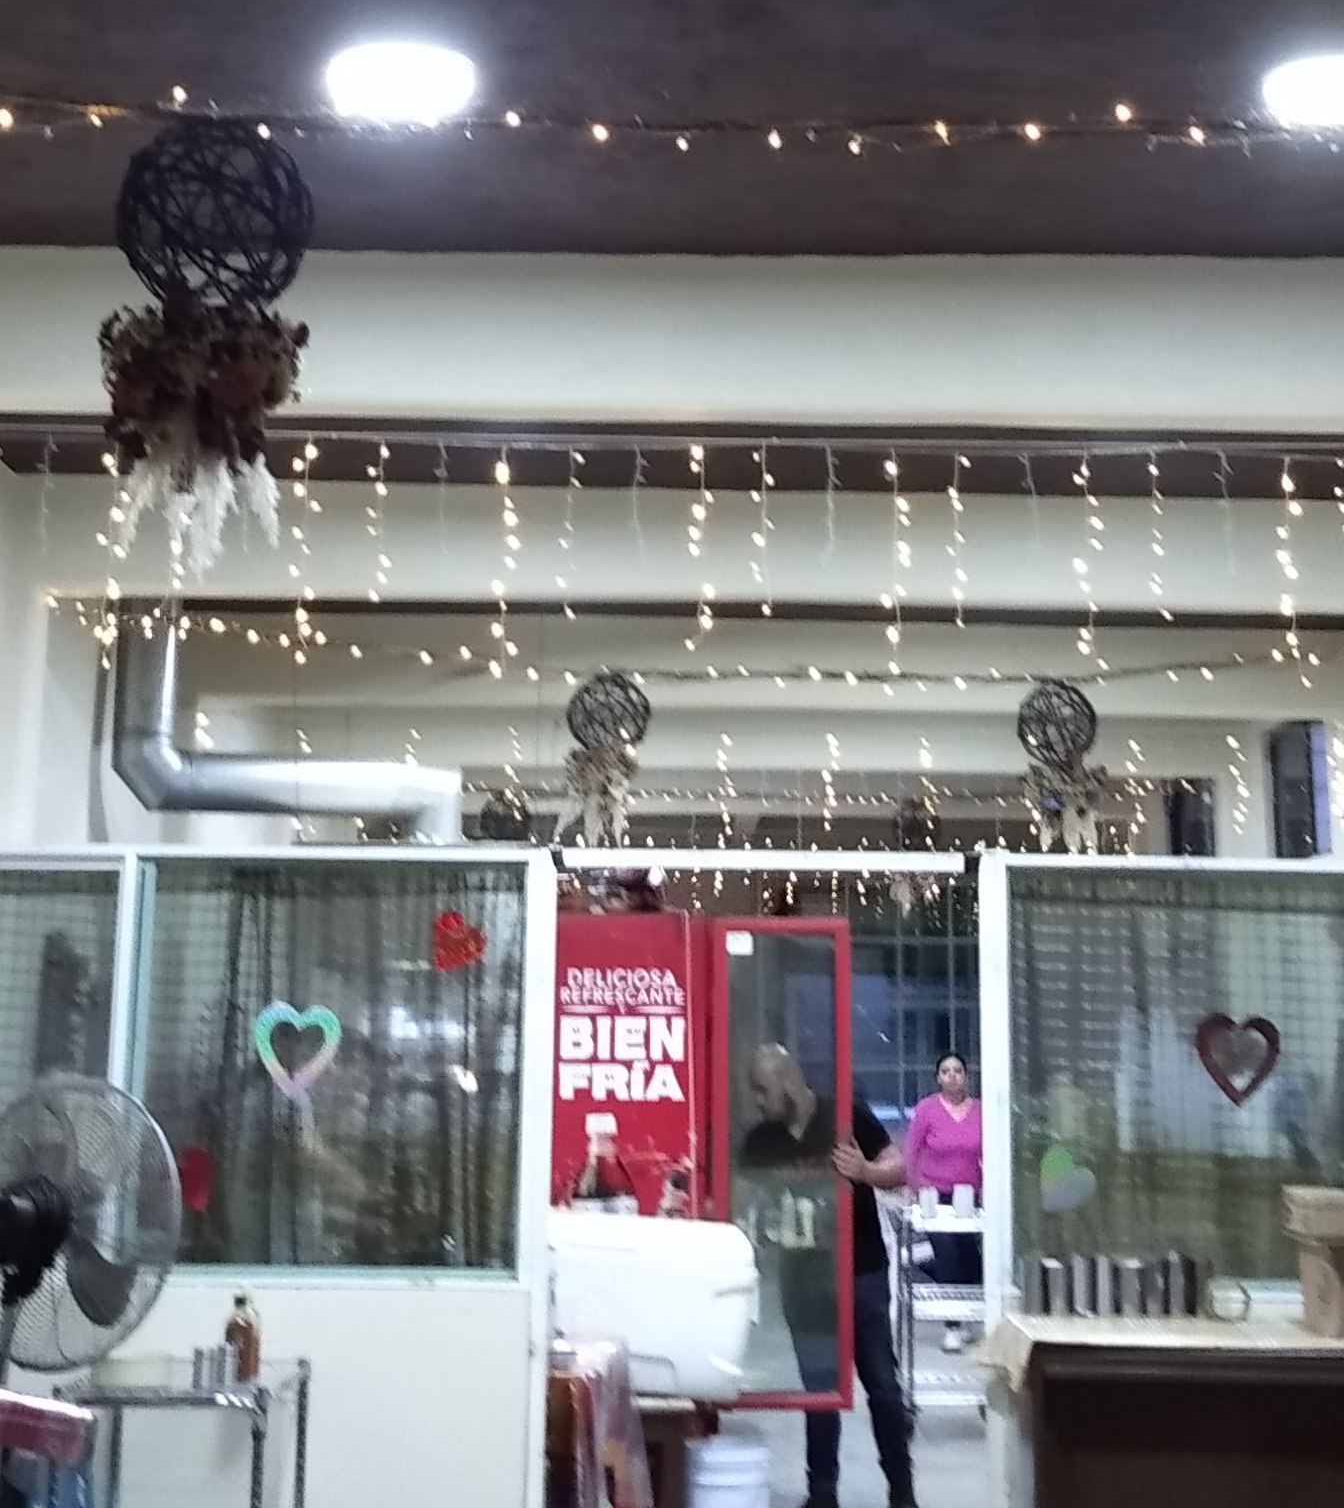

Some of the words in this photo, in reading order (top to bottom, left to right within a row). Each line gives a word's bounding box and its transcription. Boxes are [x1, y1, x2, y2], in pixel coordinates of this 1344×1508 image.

[567, 966, 677, 988] DELICIOSA
[560, 986, 685, 1006] REFRESCANTE
[559, 1014, 686, 1062] BIEN
[558, 1059, 687, 1102] FRÍA
